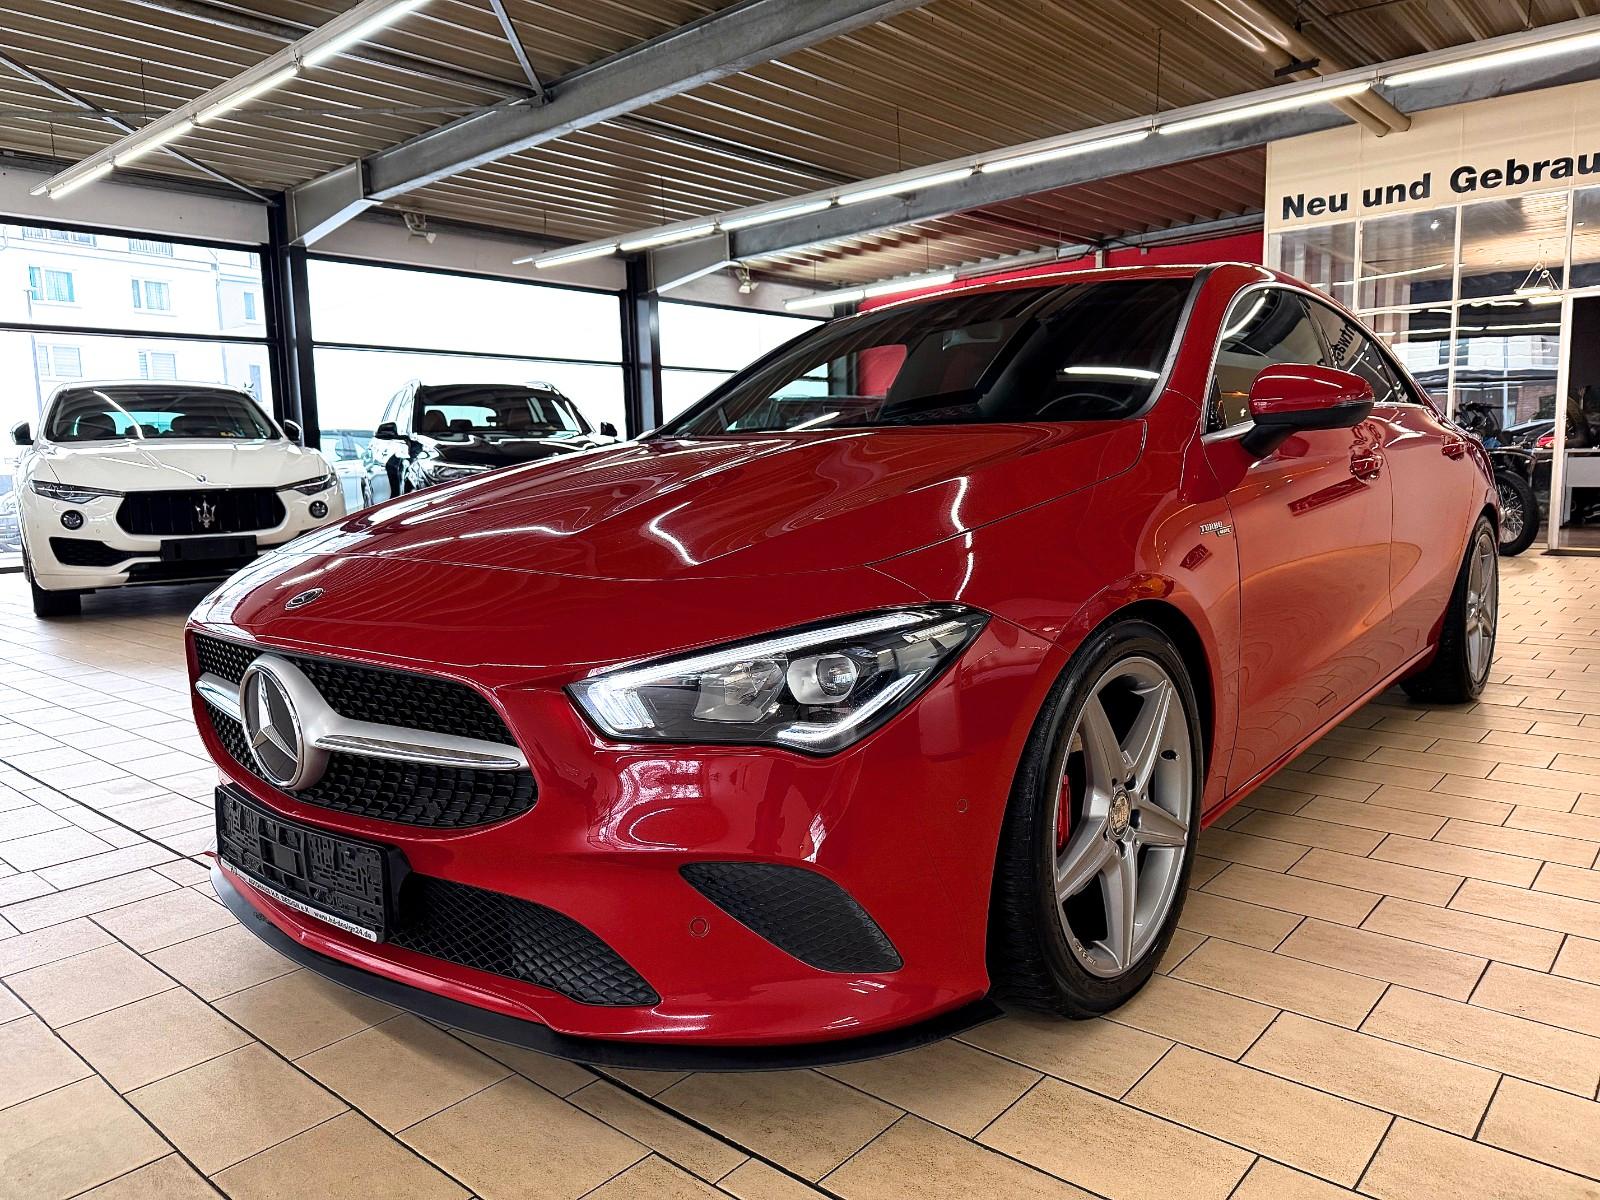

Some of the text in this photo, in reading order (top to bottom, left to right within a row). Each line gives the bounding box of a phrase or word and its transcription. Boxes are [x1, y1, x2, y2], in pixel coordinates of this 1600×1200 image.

[1282, 152, 1600, 220] Neu und Gebrau
